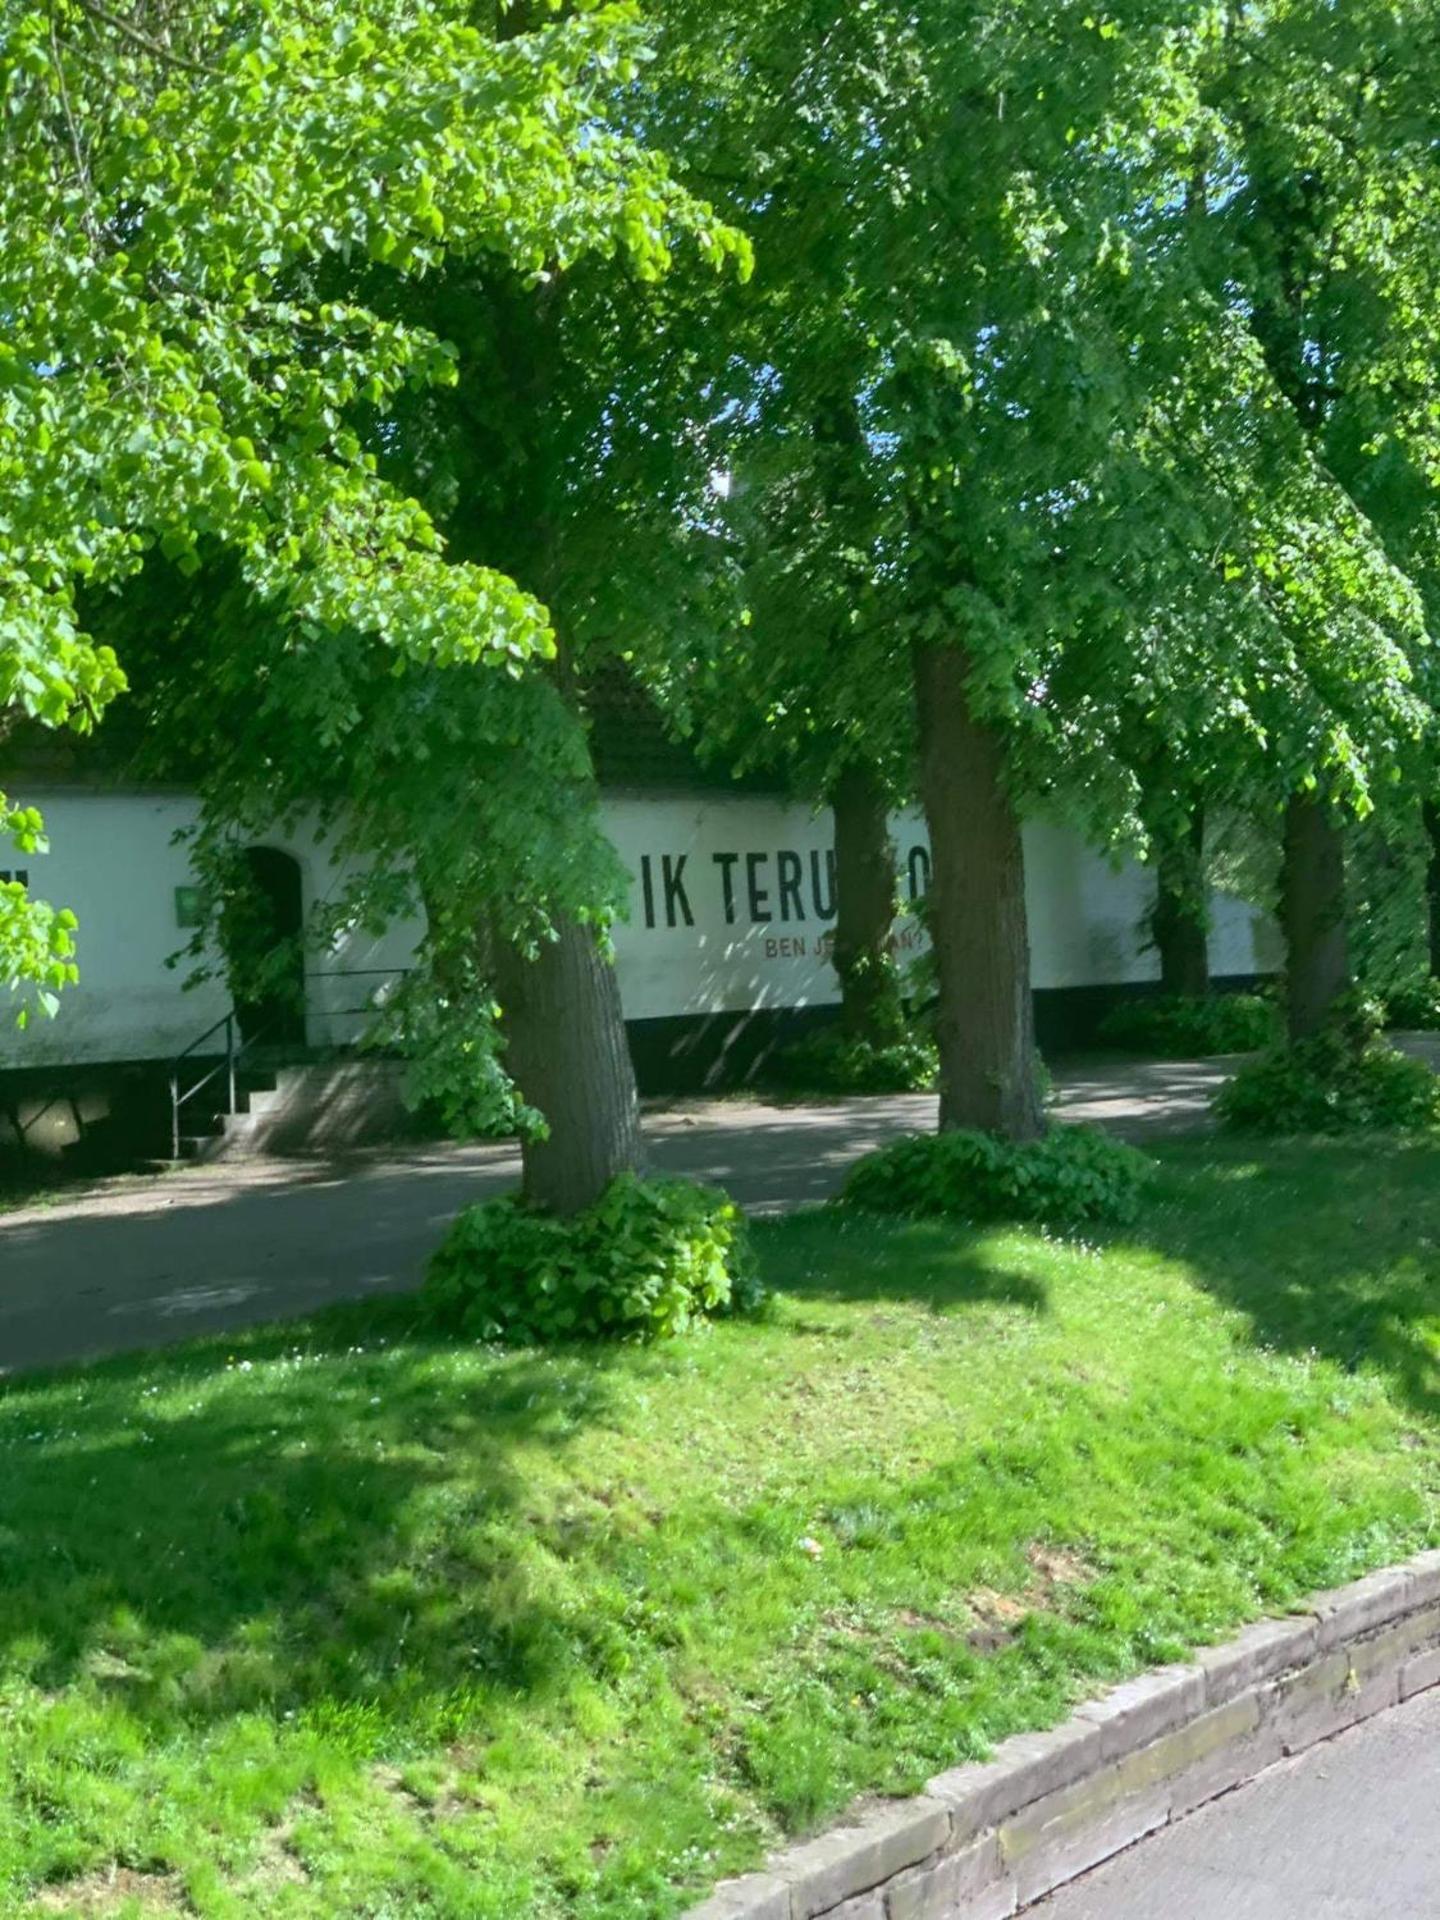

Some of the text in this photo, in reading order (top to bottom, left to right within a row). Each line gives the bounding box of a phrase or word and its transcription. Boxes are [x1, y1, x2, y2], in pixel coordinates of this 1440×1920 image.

[641, 854, 694, 929] IK
[713, 849, 840, 924] TERU
[766, 937, 806, 958] BEN
